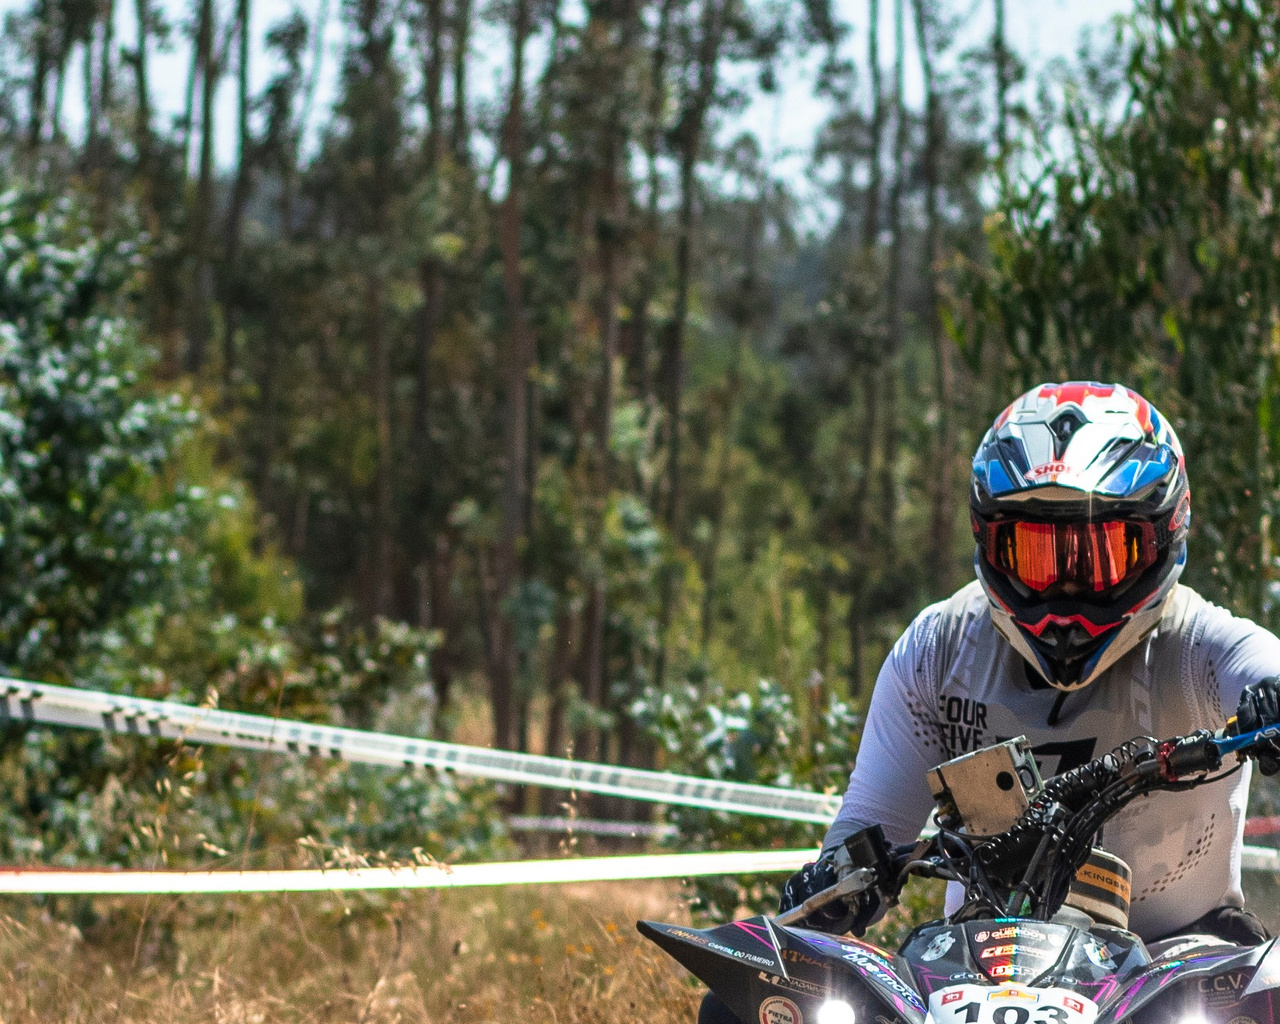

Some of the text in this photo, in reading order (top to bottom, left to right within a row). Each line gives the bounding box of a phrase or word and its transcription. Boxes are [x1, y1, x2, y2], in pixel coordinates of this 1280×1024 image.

[734, 950, 746, 958] DO
[744, 953, 775, 967] FUMEIRO
[768, 1009, 793, 1023] PIETRA
